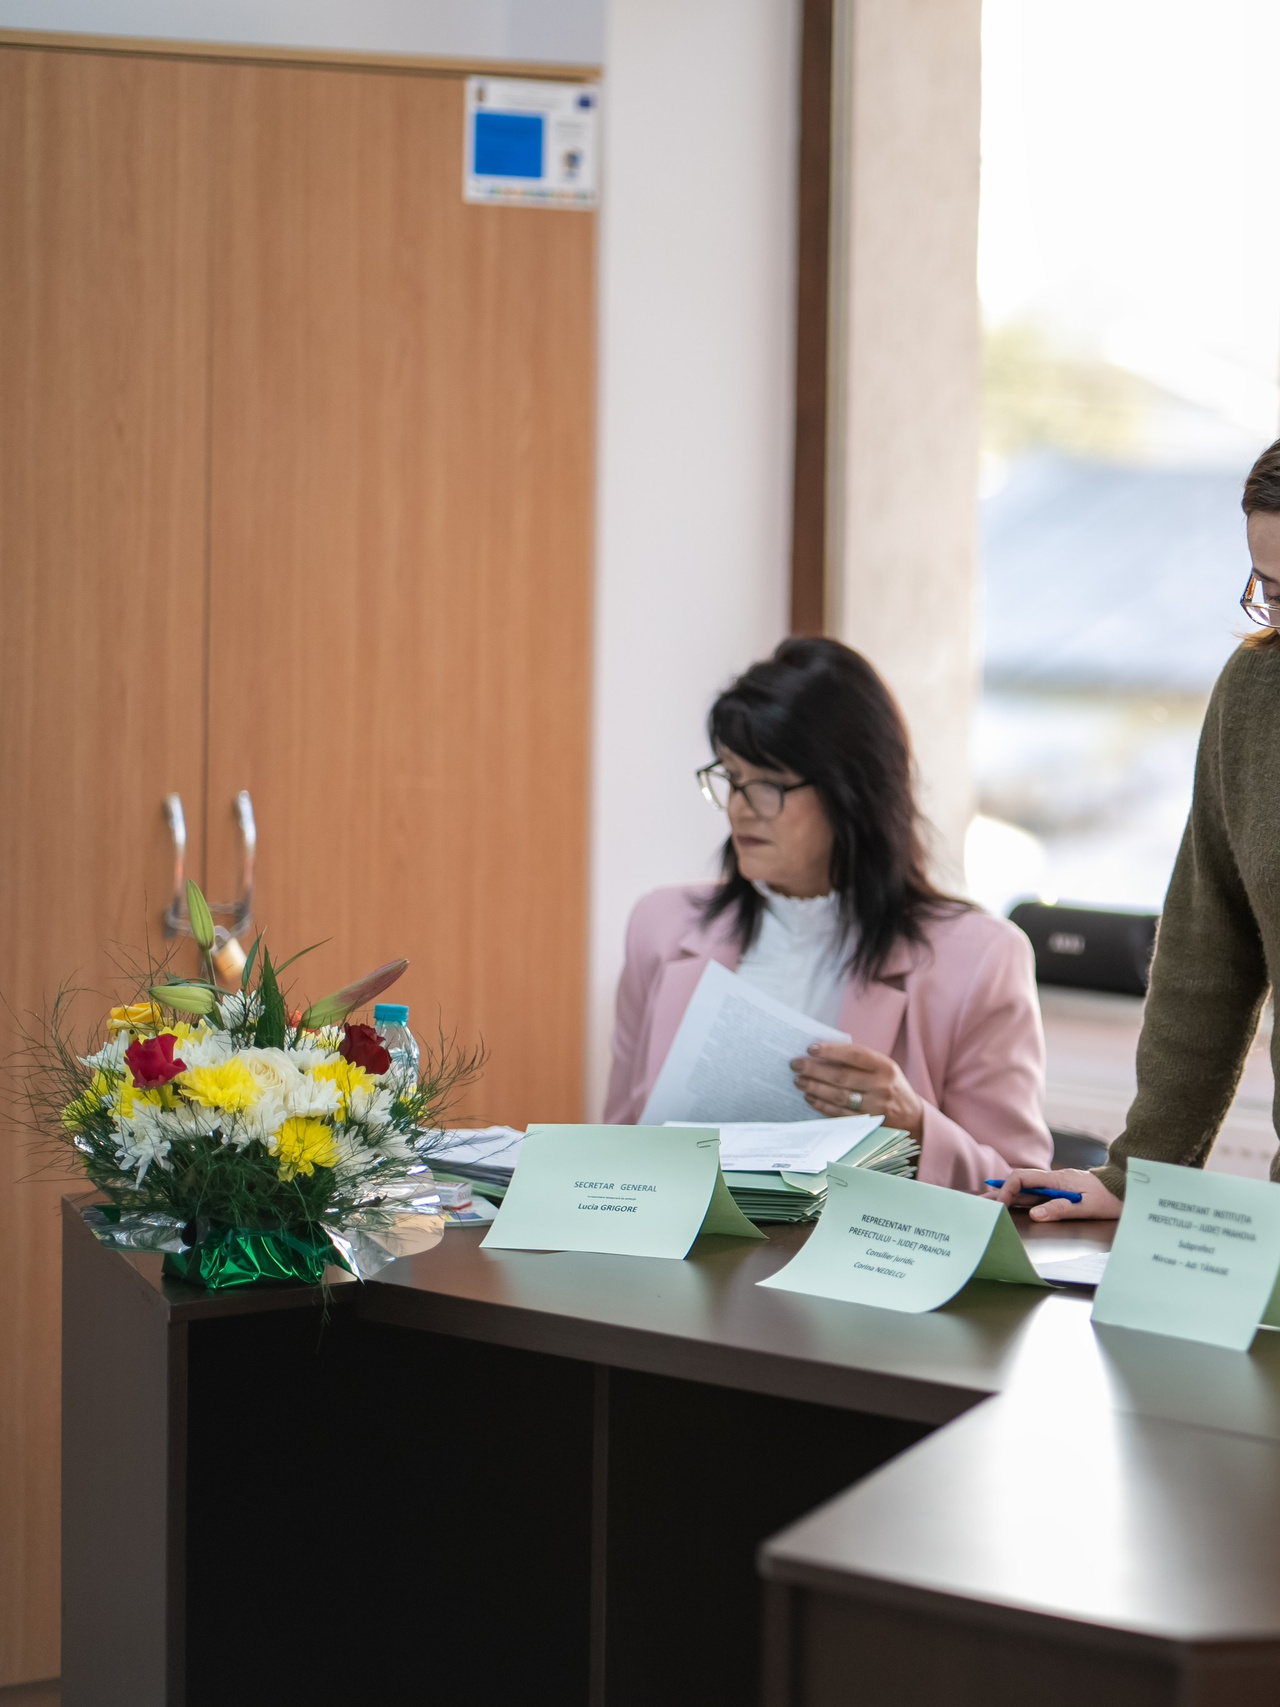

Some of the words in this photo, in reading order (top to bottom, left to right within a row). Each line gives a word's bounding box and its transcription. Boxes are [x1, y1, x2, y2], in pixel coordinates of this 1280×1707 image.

[574, 1181, 614, 1190] SECRETAR
[620, 1183, 657, 1192] GENERAL
[578, 1203, 598, 1211] Lucia
[600, 1204, 637, 1213] GRIGORE
[1158, 1198, 1210, 1215] REPREZENTANT
[861, 1214, 912, 1233] REPREZENTANT
[1148, 1213, 1192, 1229] PREFECTULUI
[1222, 1227, 1256, 1242] PRAHOVA
[848, 1226, 891, 1243] PREFECTULUI
[919, 1243, 951, 1257] PRAHOVA
[1178, 1239, 1215, 1254] Subprefect
[866, 1248, 893, 1260] Consilier
[893, 1255, 915, 1266] juridic
[853, 1261, 874, 1272] Corina
[875, 1266, 906, 1279] NEDELCU
